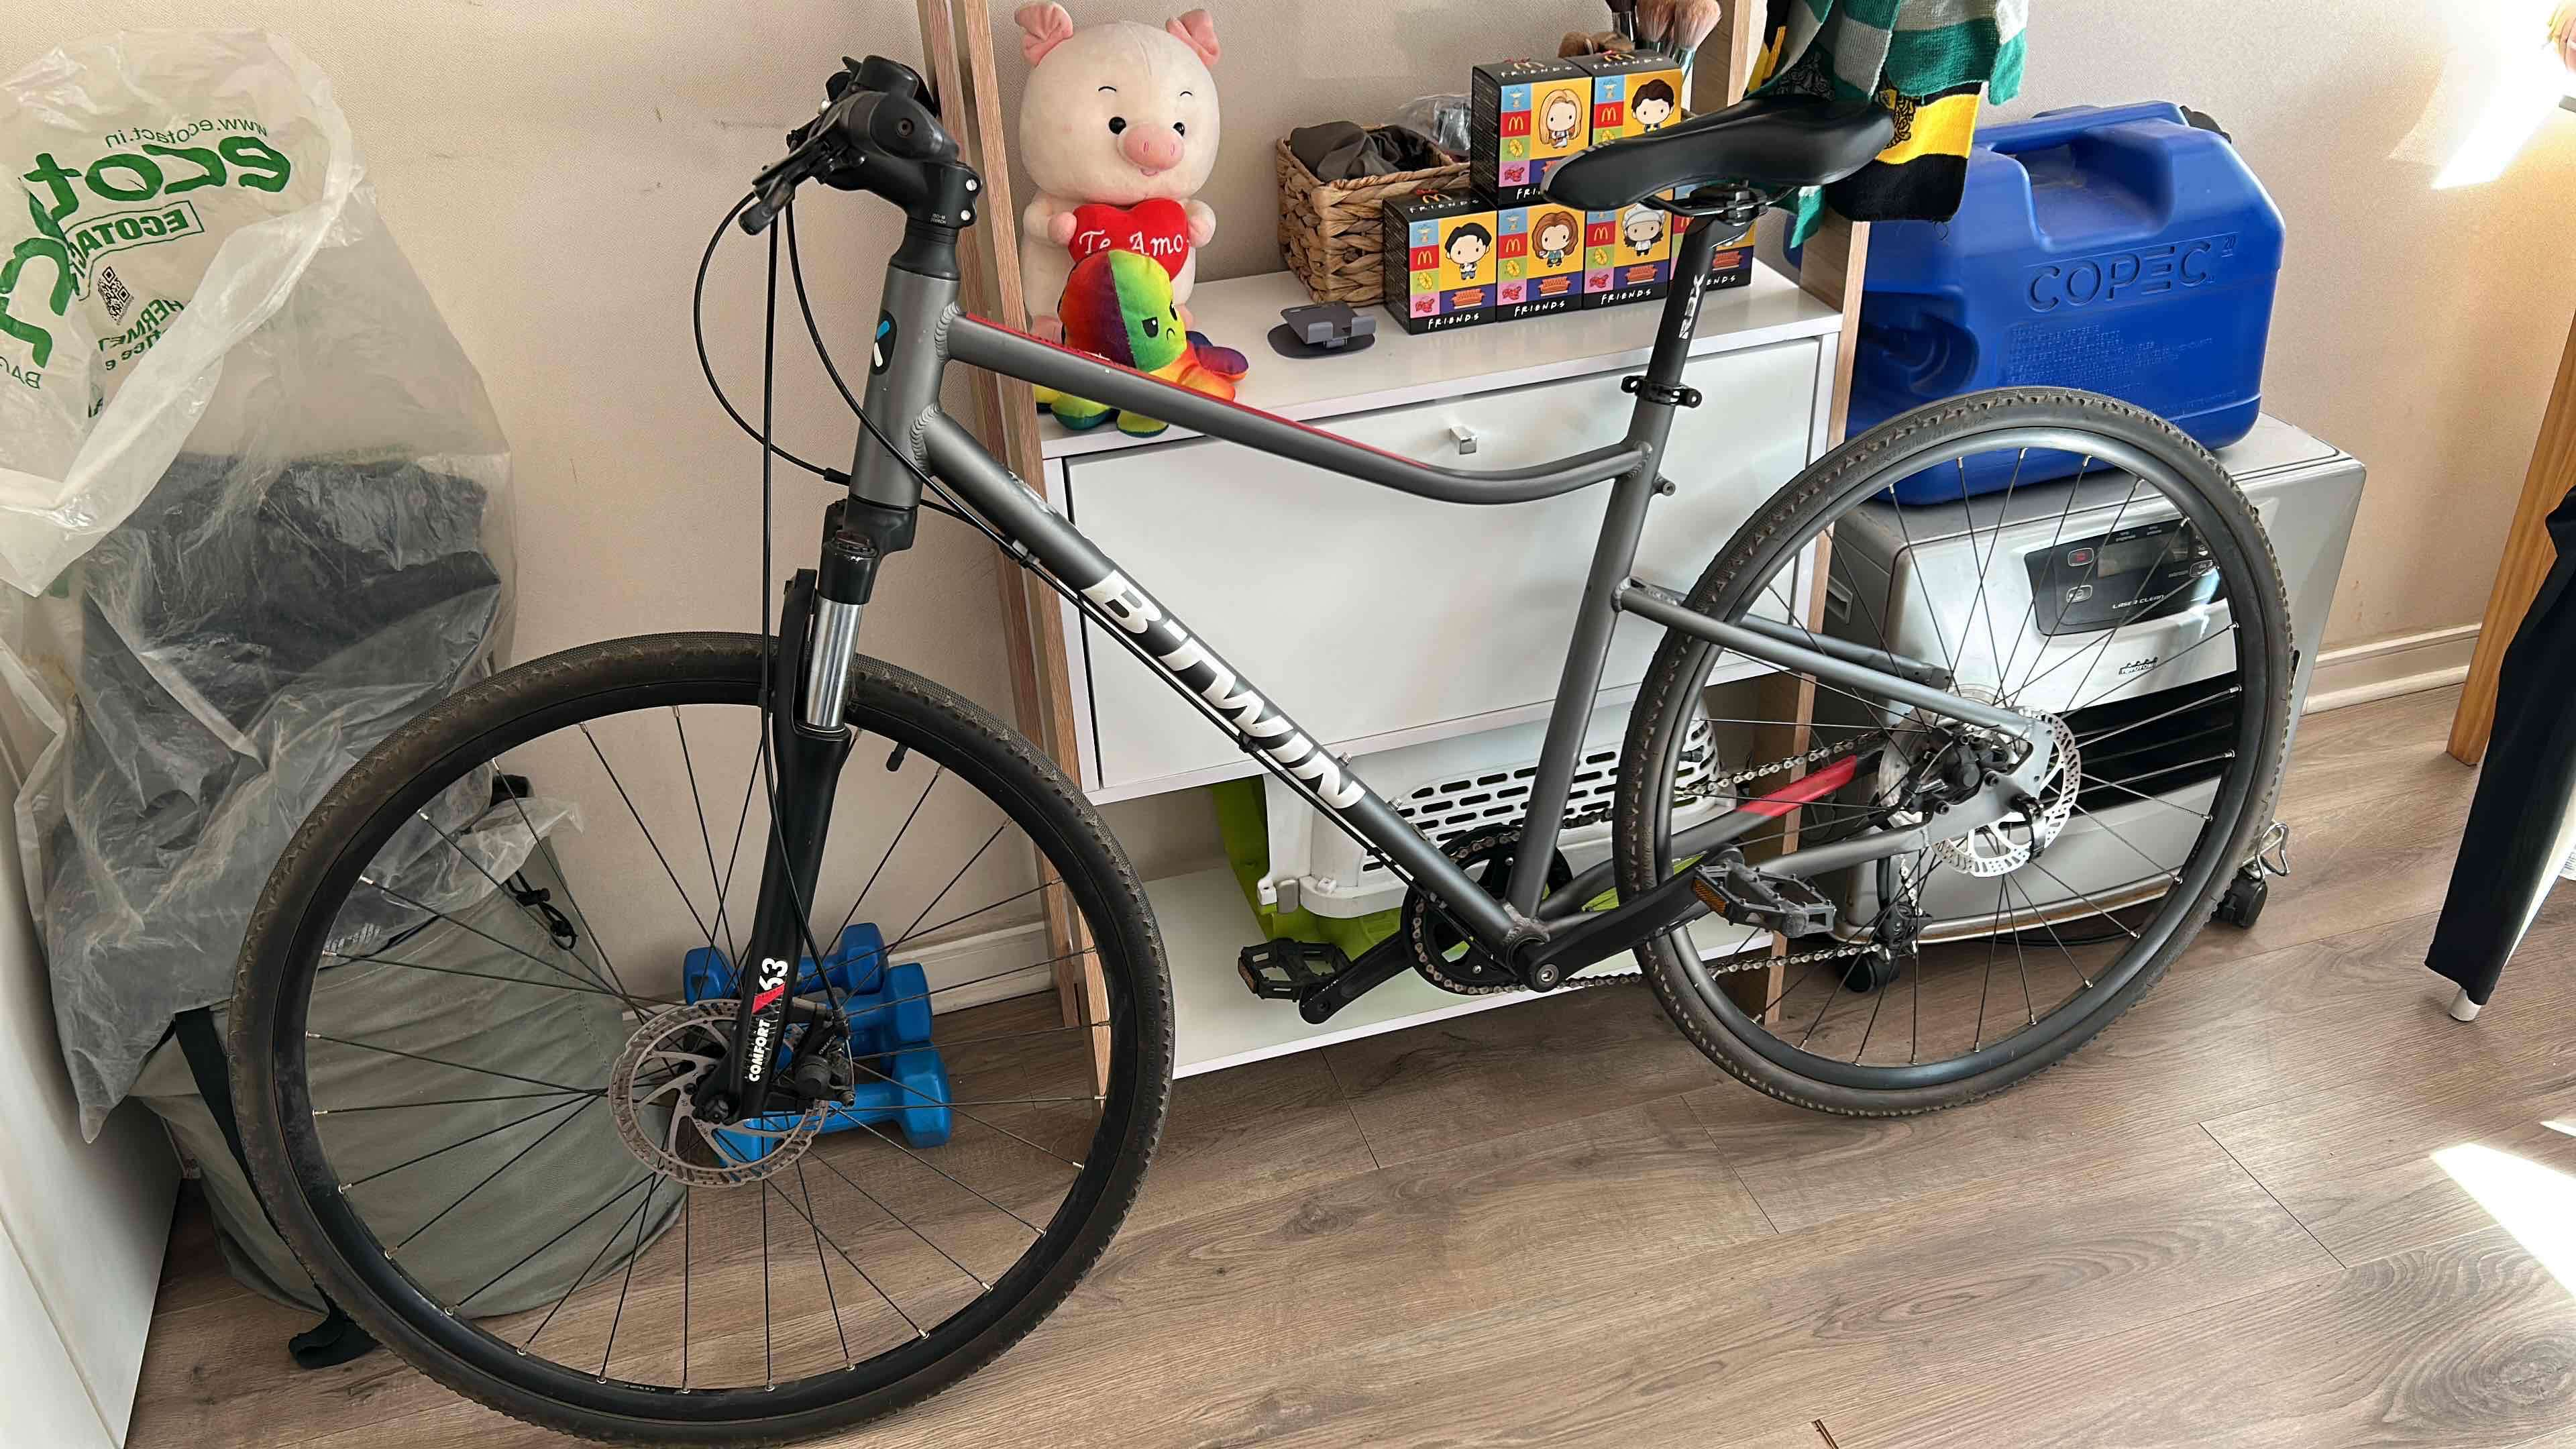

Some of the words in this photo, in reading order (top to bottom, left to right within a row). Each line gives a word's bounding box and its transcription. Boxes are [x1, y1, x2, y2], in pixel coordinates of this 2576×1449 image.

[1079, 229, 1111, 254] Te
[1130, 231, 1183, 256] Amo
[1707, 275, 1736, 285] ENDS
[2025, 241, 2212, 312] COPEC
[1601, 288, 1652, 305] FRIENDS
[1515, 301, 1565, 317] FRIENDS
[1428, 313, 1479, 329] FRIENDS
[749, 1019, 770, 1081] COMFORT
